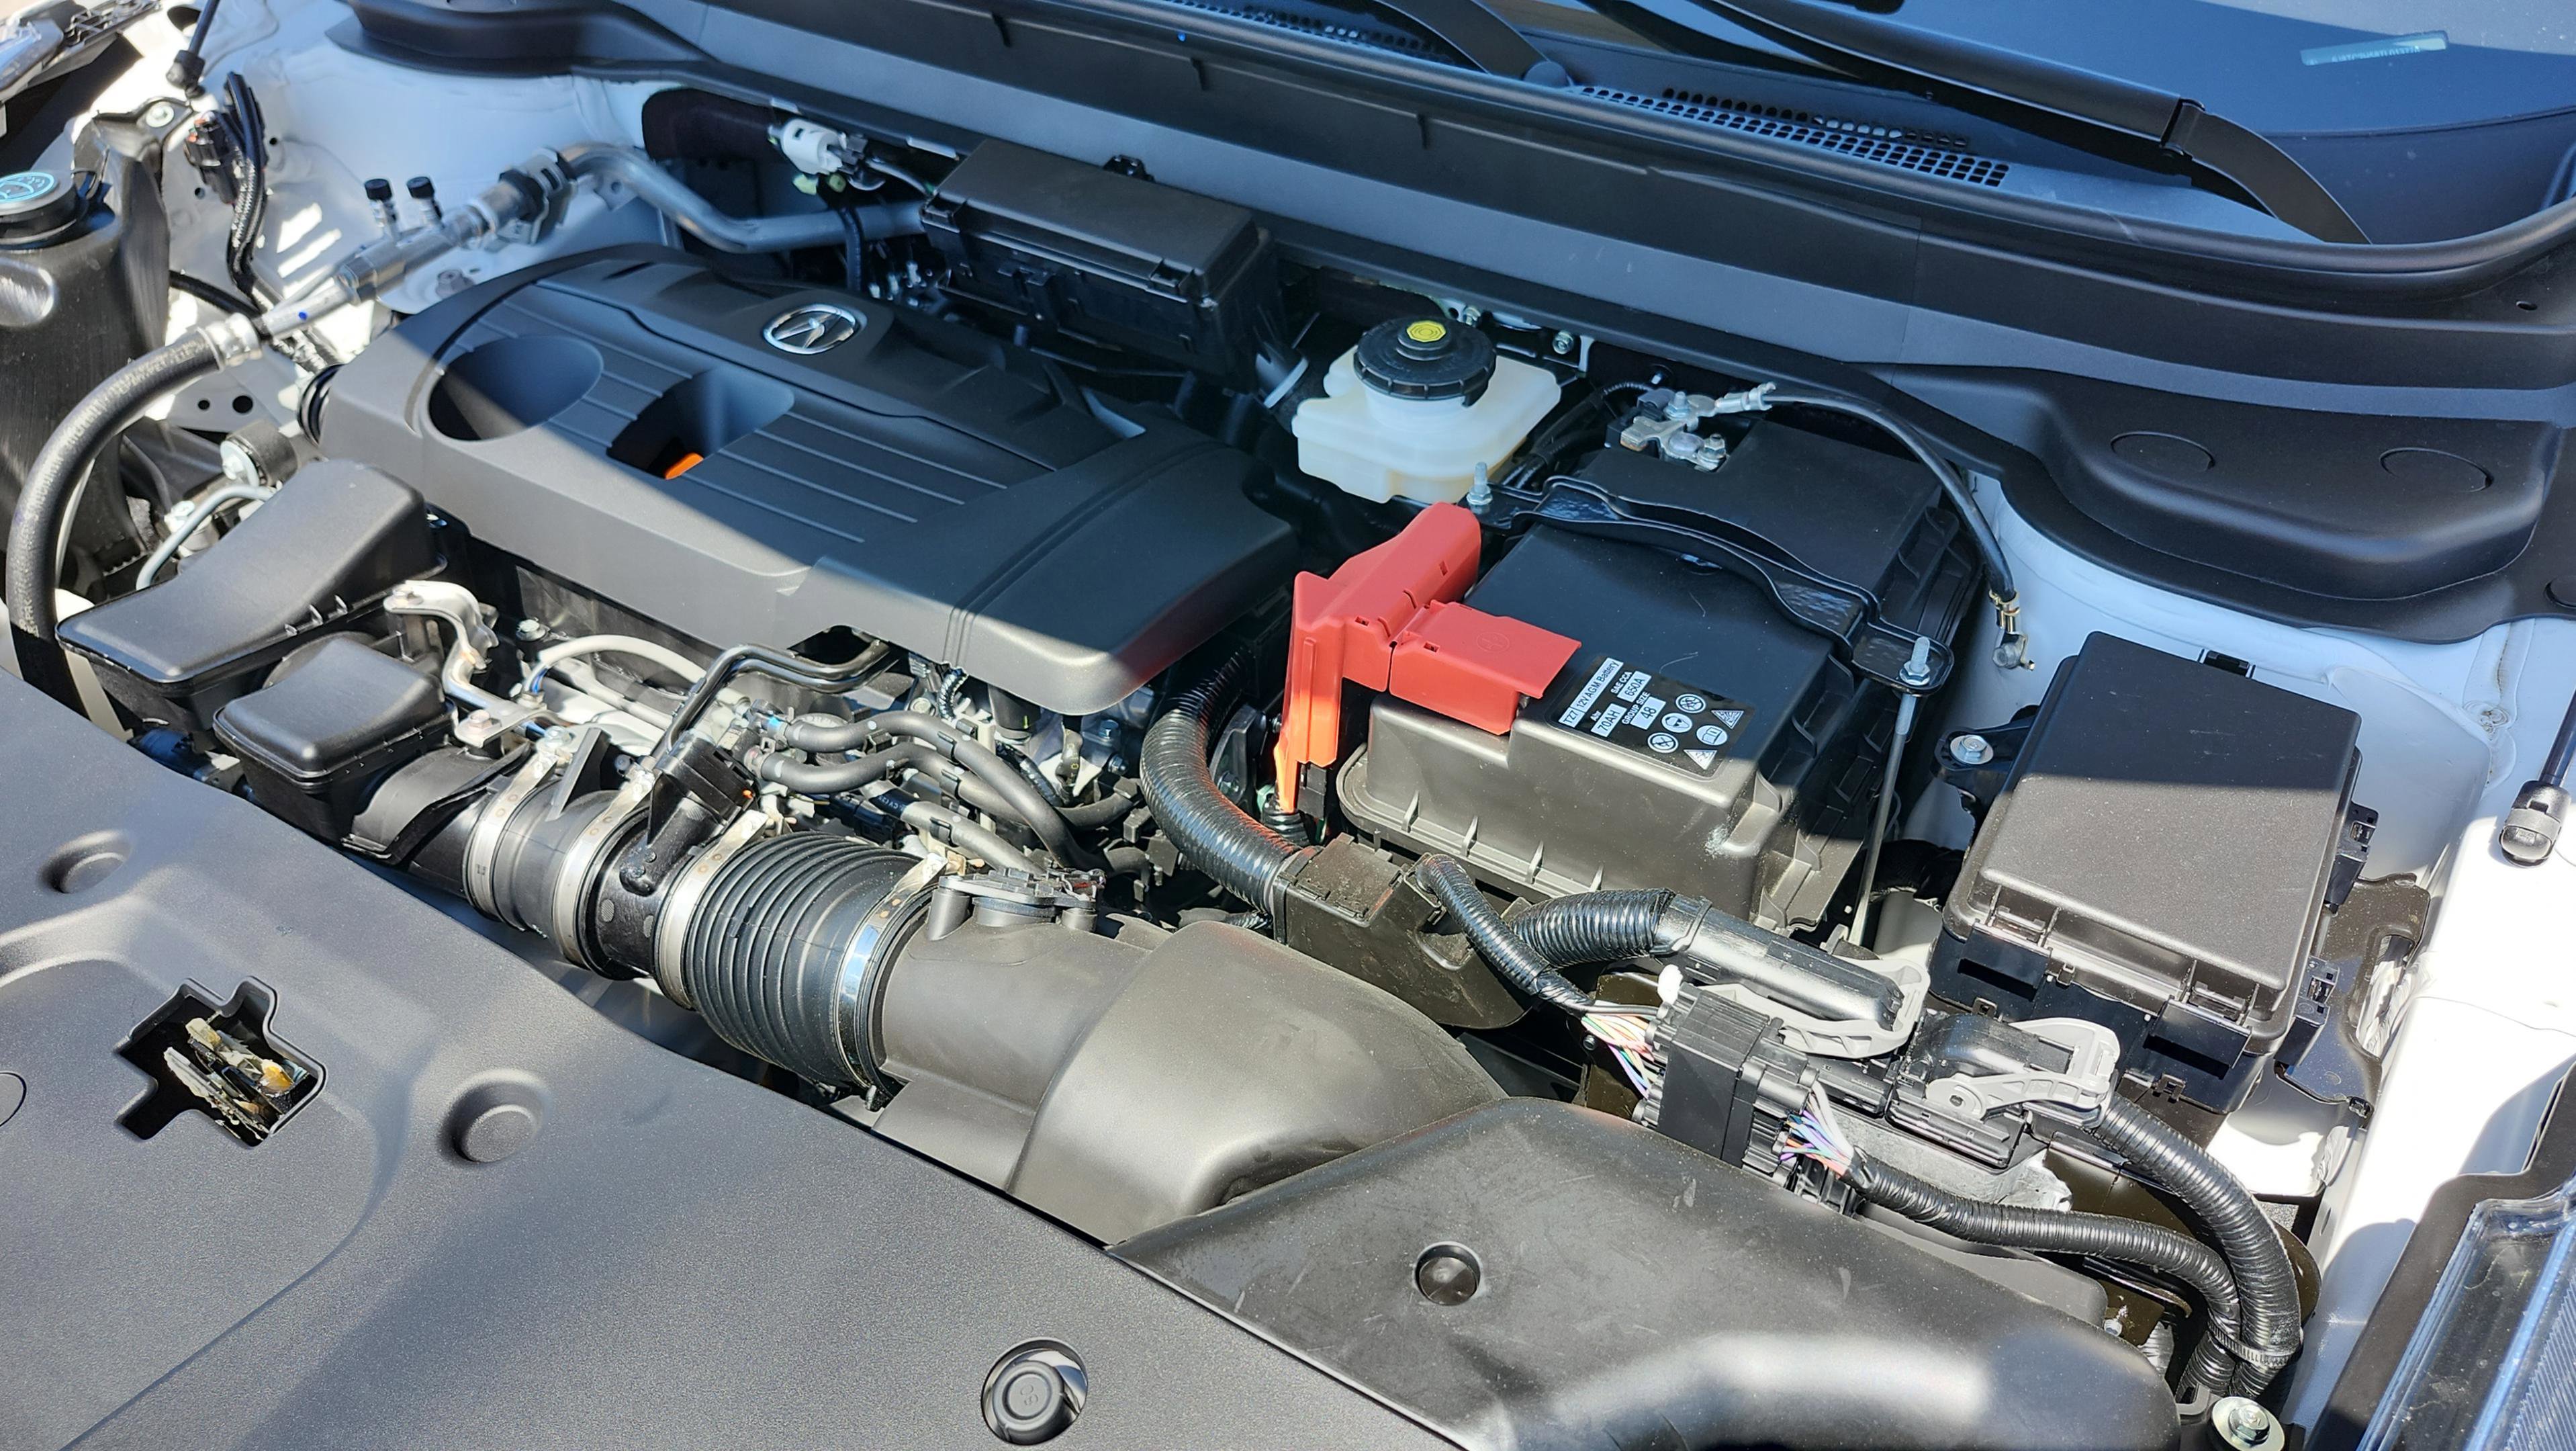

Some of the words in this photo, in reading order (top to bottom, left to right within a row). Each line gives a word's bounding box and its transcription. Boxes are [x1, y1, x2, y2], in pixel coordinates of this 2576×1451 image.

[1577, 695, 1590, 708] 12V
[1587, 680, 1602, 699] AGM
[1597, 661, 1620, 682] Battery
[1610, 681, 1624, 694] SAE
[1619, 671, 1632, 683] CCA
[1624, 678, 1645, 697] 650A
[1563, 710, 1579, 724] TZ7
[1622, 704, 1640, 725] GROUP
[1637, 691, 1651, 705] SIZE
[1641, 706, 1657, 719] 48
[1598, 710, 1620, 732] 70AH
